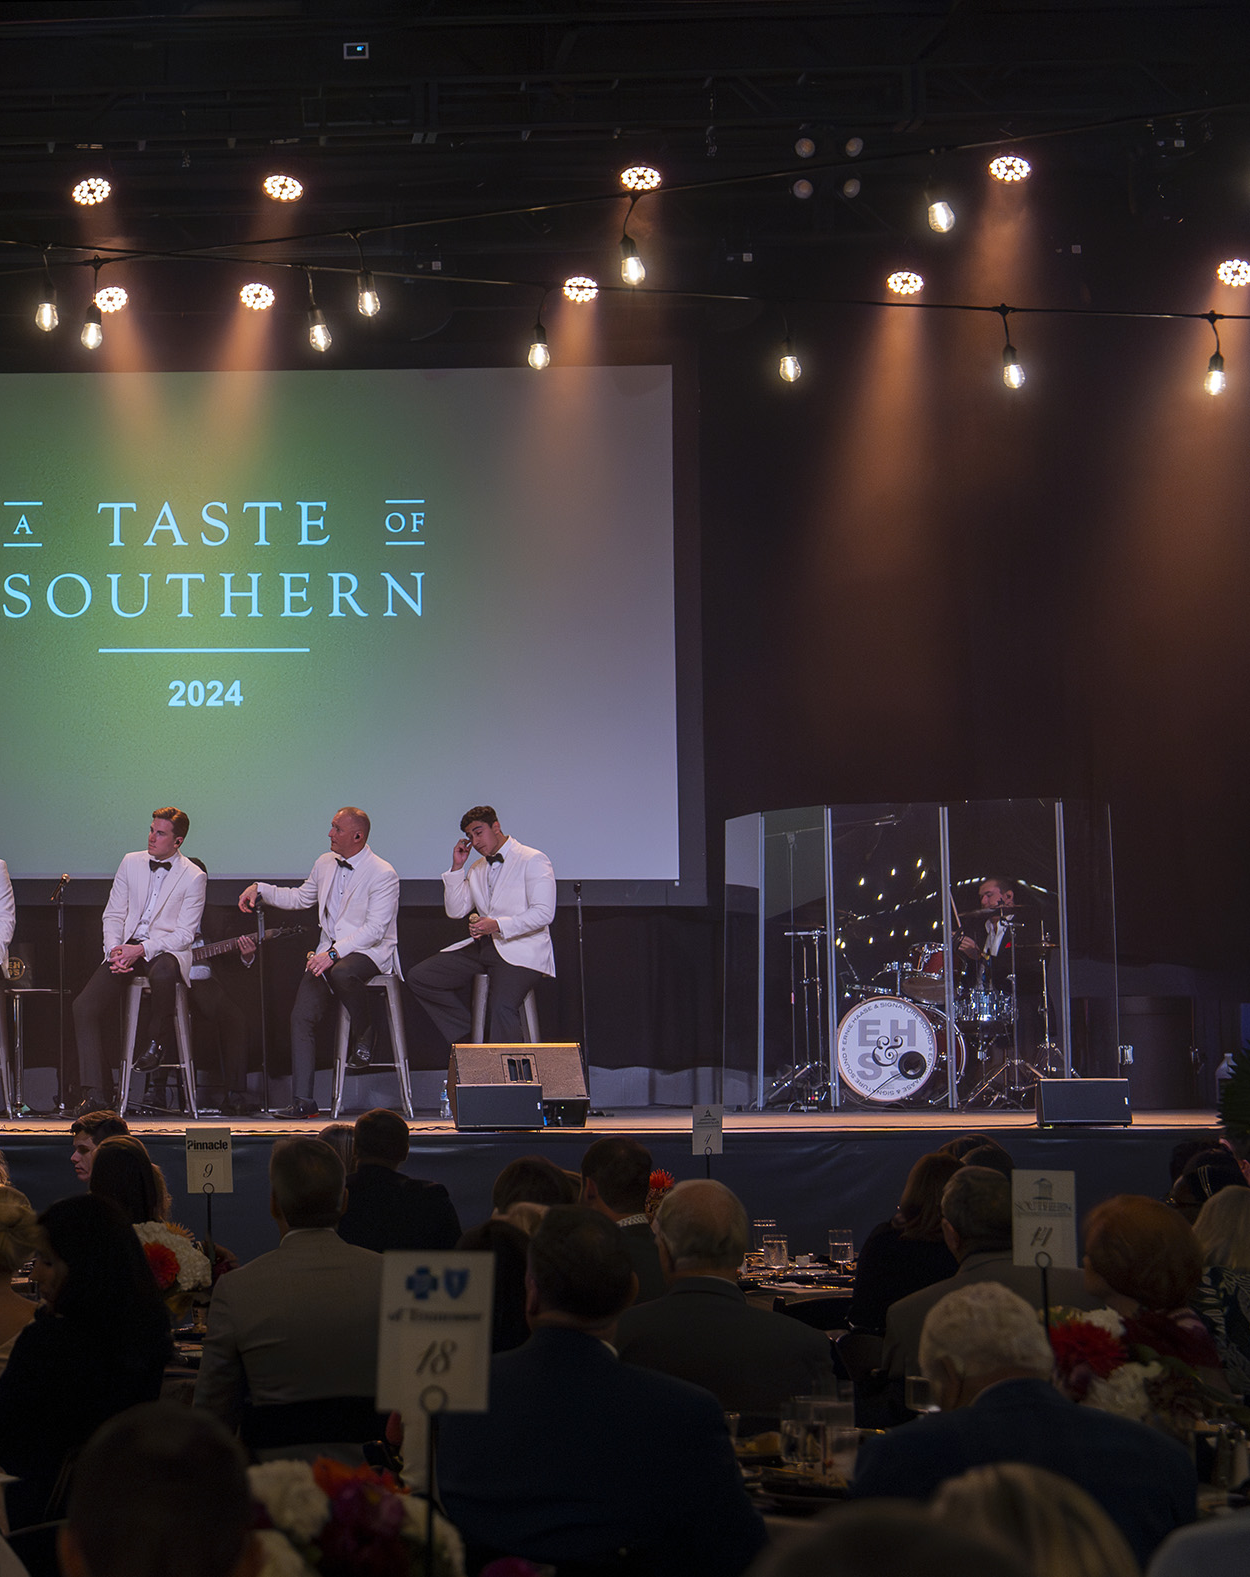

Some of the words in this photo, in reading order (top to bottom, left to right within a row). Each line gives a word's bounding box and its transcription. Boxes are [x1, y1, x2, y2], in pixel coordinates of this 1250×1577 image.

[13, 514, 33, 535] A
[97, 501, 330, 547] TASTE
[385, 512, 425, 533] OF
[2, 572, 426, 619] SOUTHERN
[168, 679, 244, 707] 2024
[842, 1022, 854, 1045] ERNIE
[852, 1005, 874, 1024] HAASE
[879, 1002, 919, 1020] SIGNATURE
[858, 1019, 916, 1047] EH
[187, 1140, 228, 1150] Pinnacle
[203, 1163, 214, 1178] 9
[416, 1340, 458, 1377] 18
